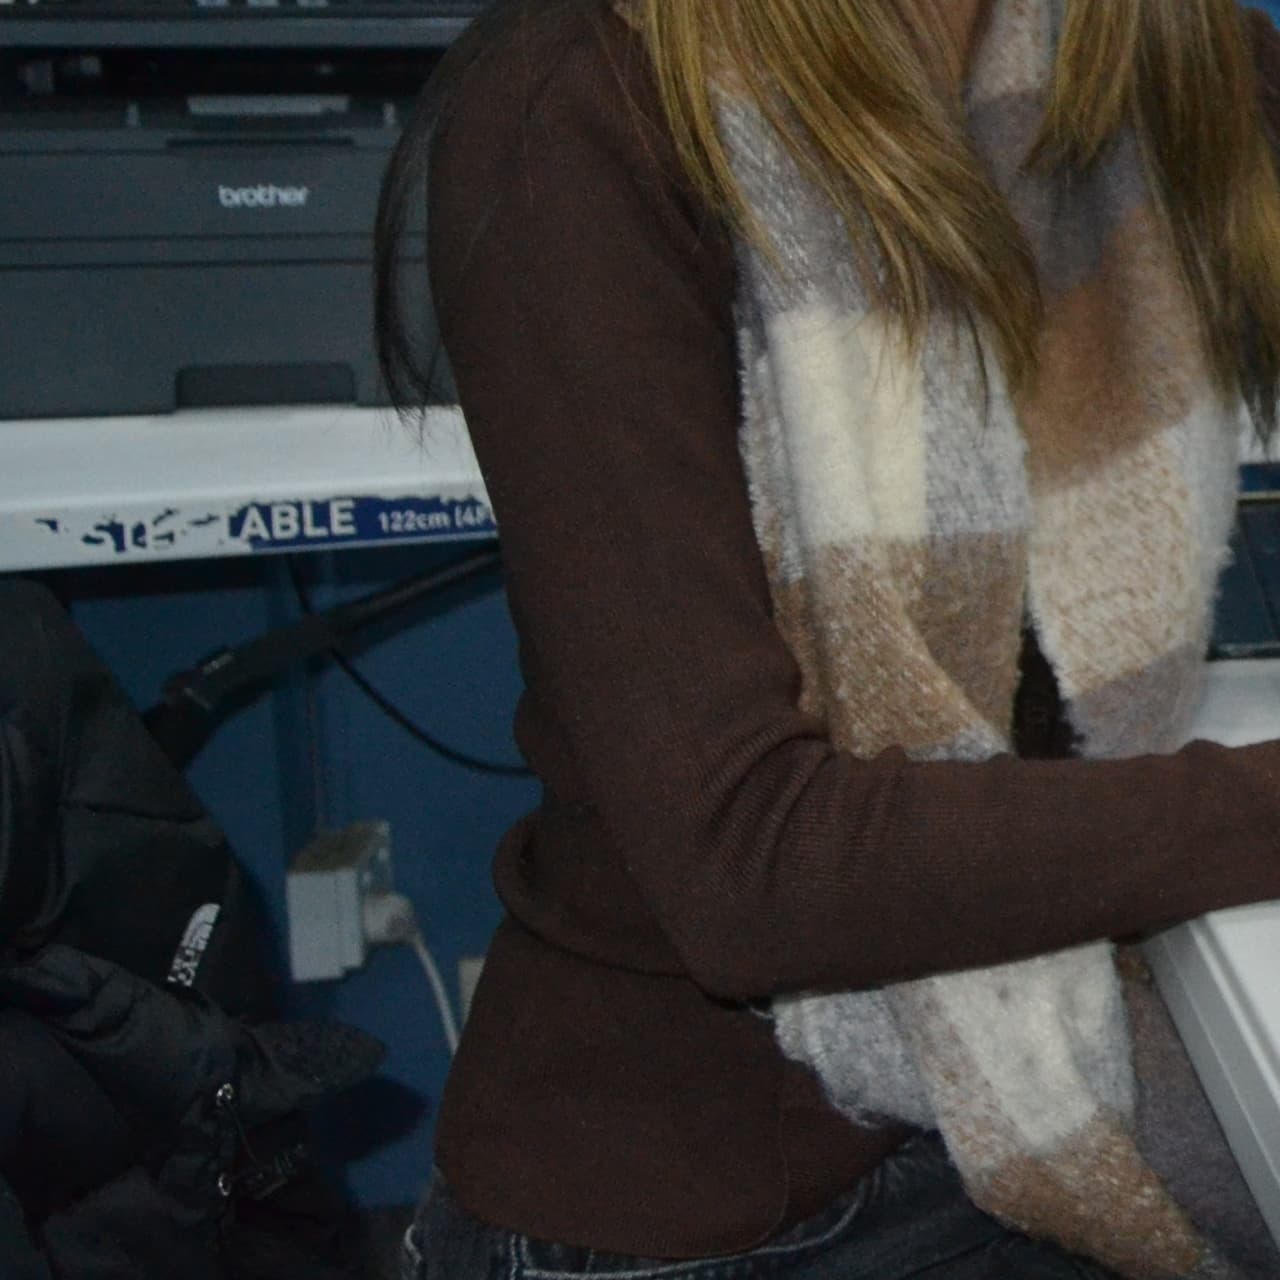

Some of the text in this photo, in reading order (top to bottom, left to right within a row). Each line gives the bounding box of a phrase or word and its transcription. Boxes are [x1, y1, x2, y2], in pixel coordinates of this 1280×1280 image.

[218, 184, 308, 208] brother
[233, 499, 357, 541] ABLE
[378, 508, 449, 533] 122cm
